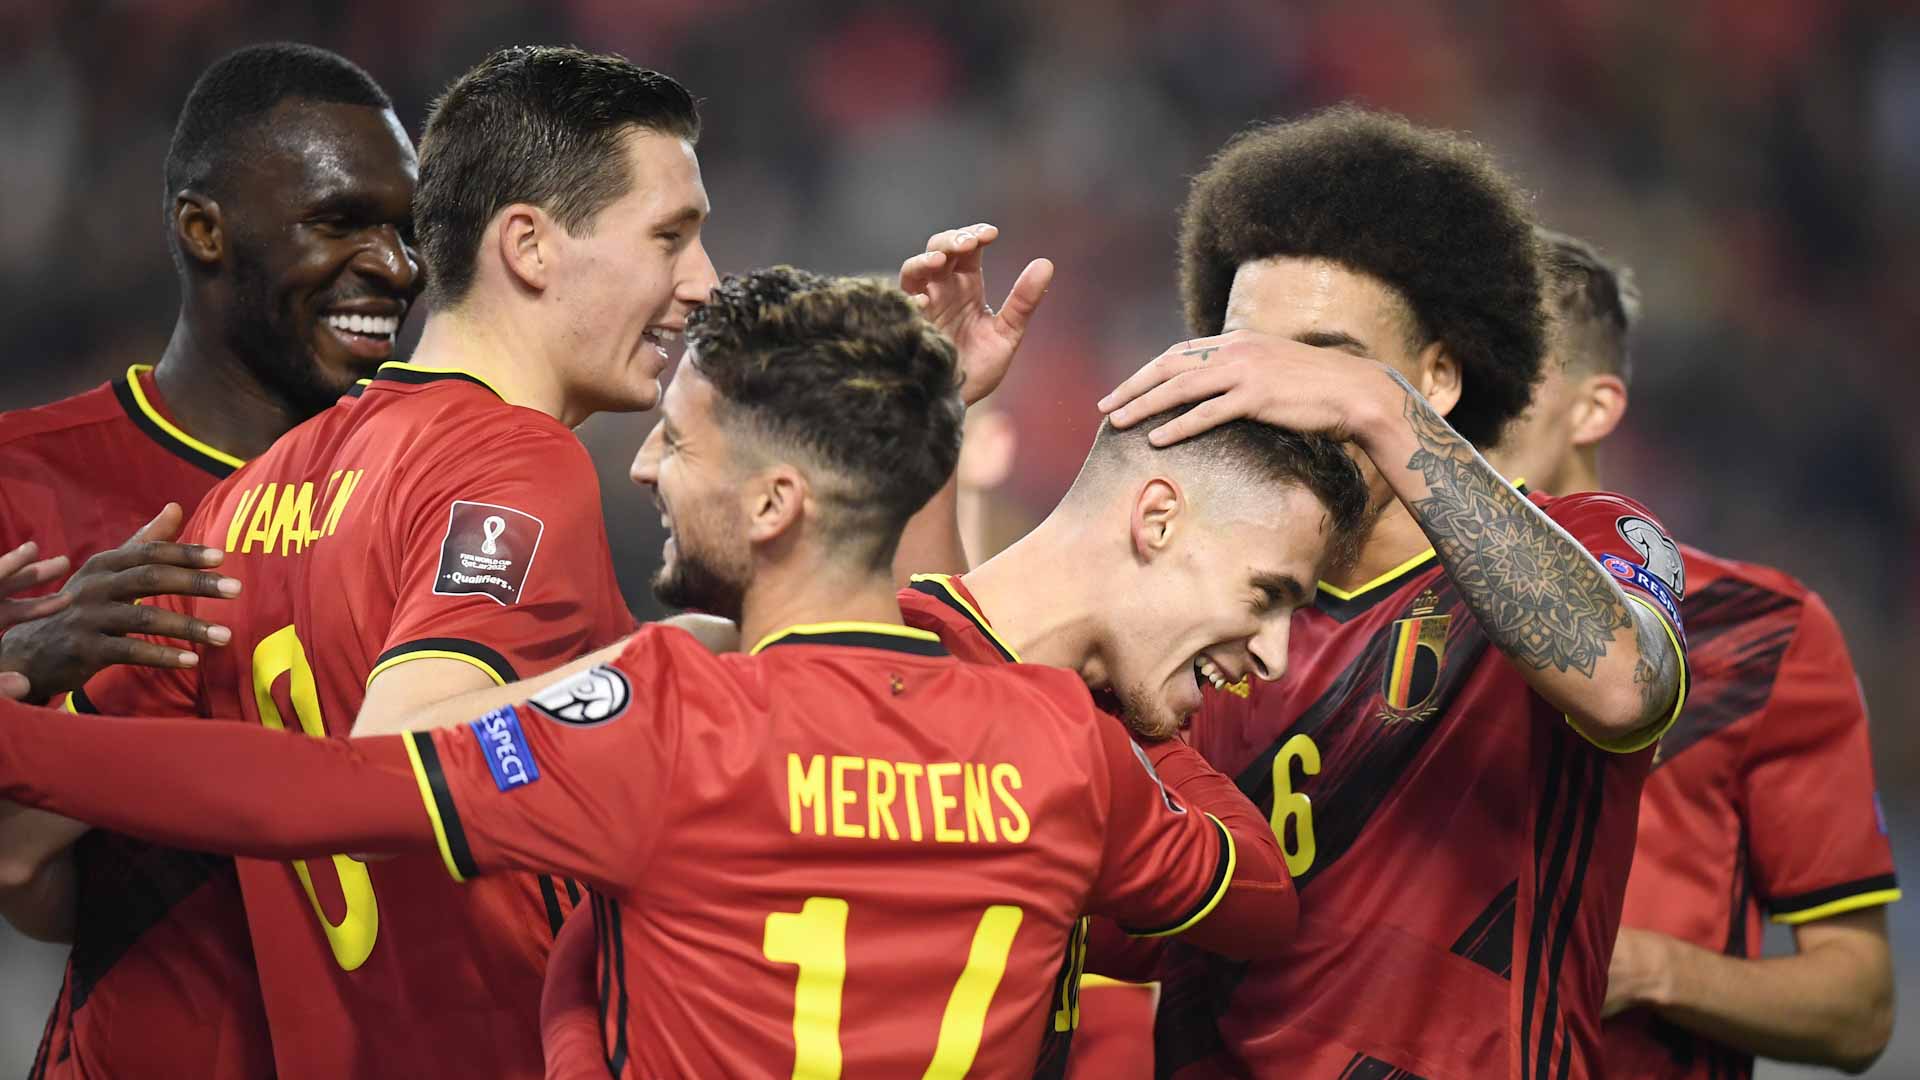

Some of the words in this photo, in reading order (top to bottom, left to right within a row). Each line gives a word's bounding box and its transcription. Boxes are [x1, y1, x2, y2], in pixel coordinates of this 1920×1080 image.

[225, 469, 364, 557] VANAN
[452, 571, 508, 589] Qualifiers
[460, 553, 474, 561] FIFA
[474, 555, 498, 565] WORLD
[480, 708, 529, 785] ESPECT
[787, 752, 1031, 844] MERTENS
[1270, 733, 1321, 878] 6
